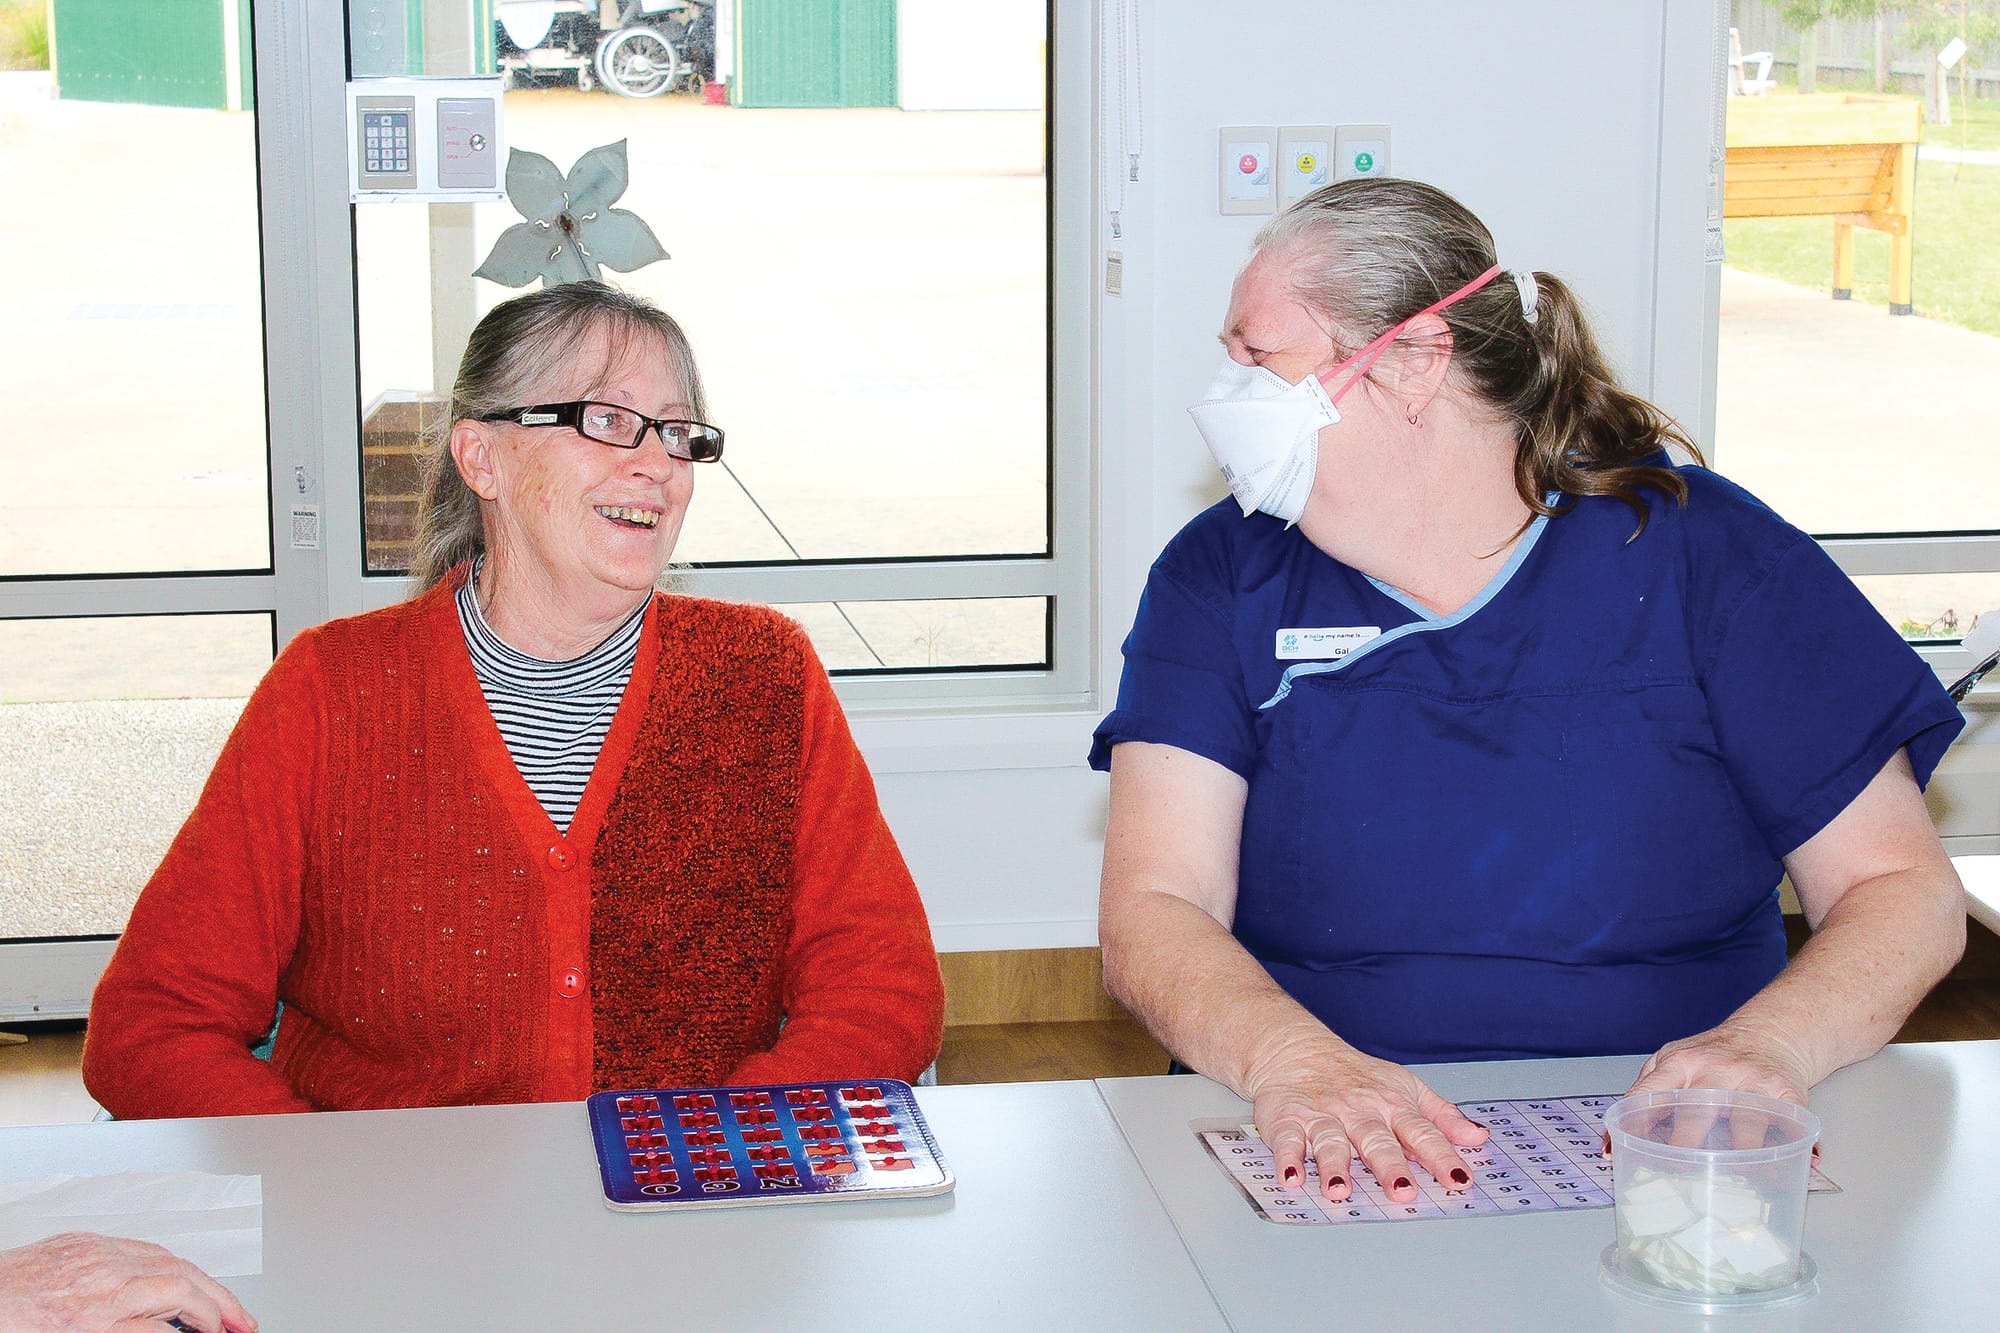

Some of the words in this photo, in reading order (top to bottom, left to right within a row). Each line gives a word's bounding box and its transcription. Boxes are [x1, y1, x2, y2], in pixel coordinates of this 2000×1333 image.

[1472, 1158, 1497, 1166] 36
[1527, 1155, 1552, 1163] 35
[1486, 1171, 1510, 1180] 26
[1541, 1168, 1566, 1176] 25
[1499, 1184, 1523, 1193] 16
[1554, 1181, 1579, 1190] 15
[1518, 1198, 1531, 1206] 6
